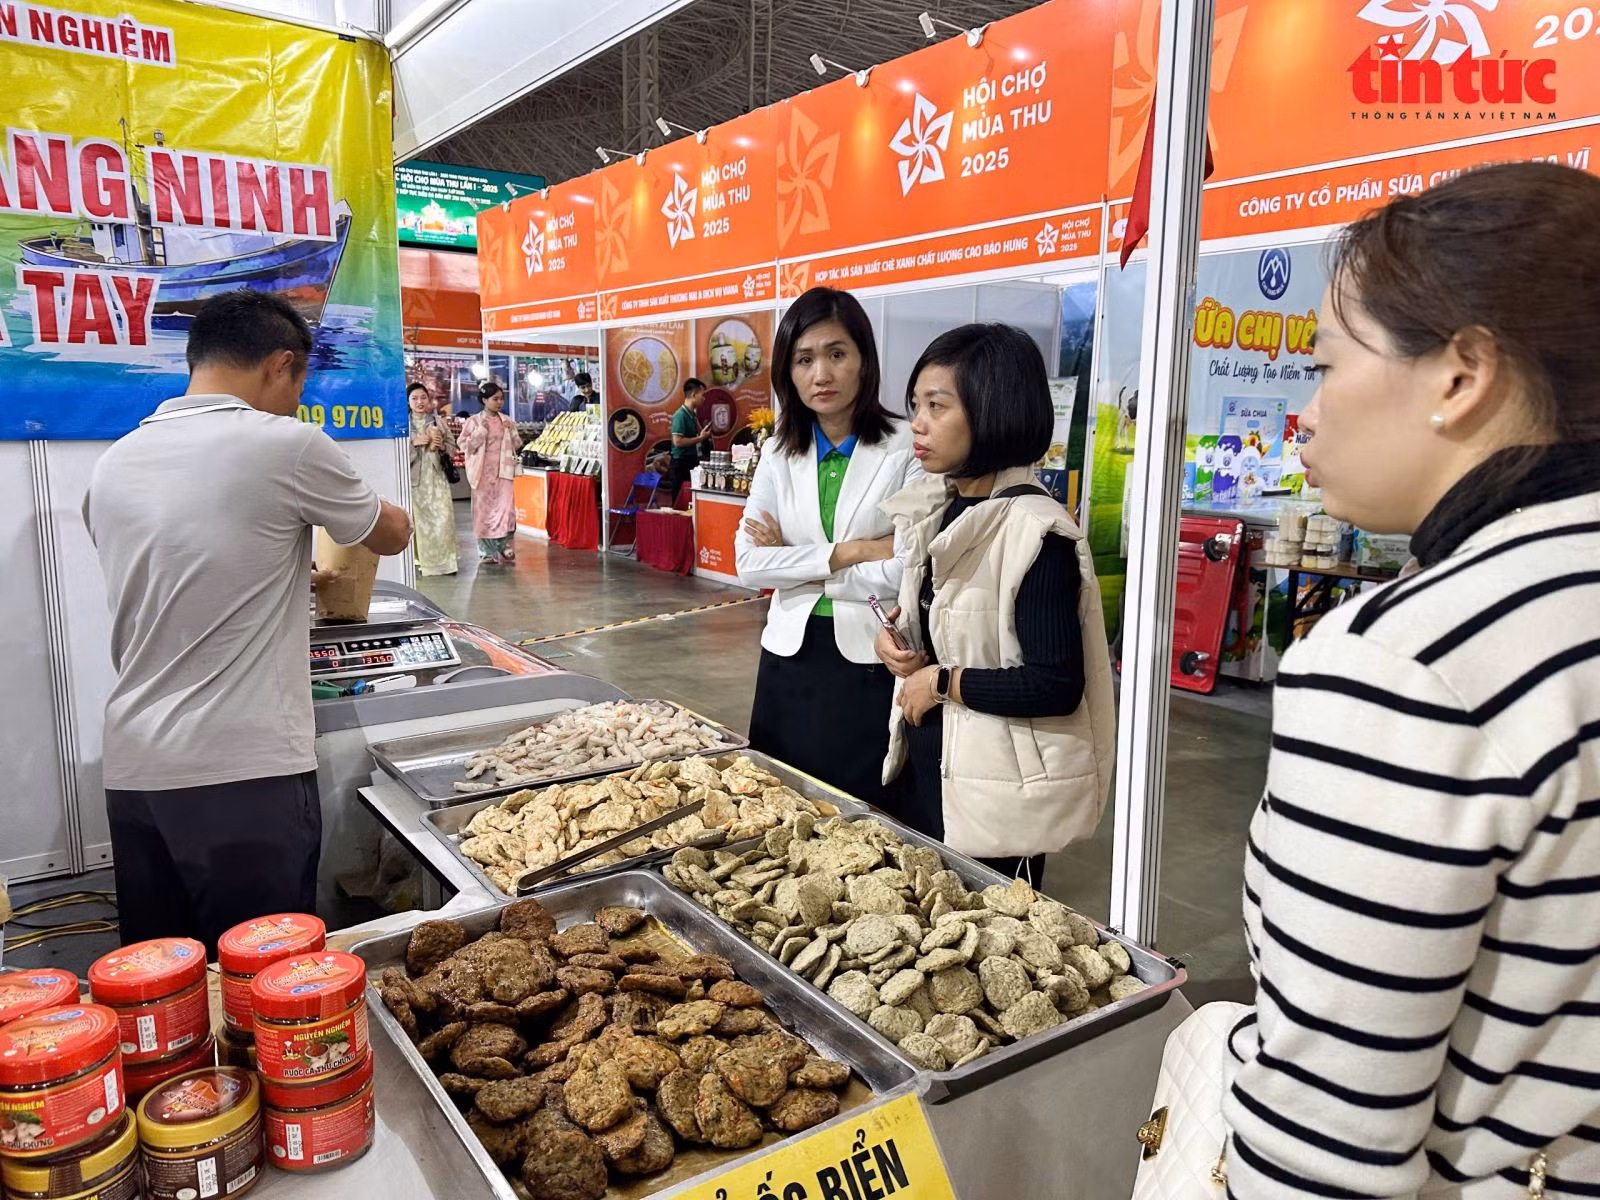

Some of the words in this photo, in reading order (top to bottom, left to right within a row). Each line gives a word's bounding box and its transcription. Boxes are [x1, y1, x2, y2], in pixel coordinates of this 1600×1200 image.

[28, 9, 171, 63] NGHIÊM
[1532, 6, 1600, 49] 20
[963, 76, 996, 110] HỘI
[1001, 60, 1047, 94] CHỢ
[962, 111, 1004, 144] MÙA
[1010, 100, 1052, 130] THU
[701, 164, 720, 189] HỘI
[722, 155, 747, 180] CHỢ
[961, 146, 1009, 177] 2025
[0, 134, 129, 219] NG
[150, 151, 332, 237] NINH
[702, 189, 726, 213] MÙA
[728, 184, 751, 206] THU
[1239, 196, 1281, 217] CÔNG
[1284, 192, 1305, 211] TY
[1307, 182, 1331, 207] CỔ
[1335, 176, 1383, 203] PHẦN
[1387, 173, 1424, 197] SỮA
[559, 209, 575, 230] CHỢ
[703, 217, 730, 238] 2025
[1077, 229, 1092, 240] THU
[563, 232, 578, 249] THU
[895, 256, 916, 270] XANH
[917, 249, 936, 267] CHẤT
[936, 246, 963, 264] LƯỢNG
[965, 244, 982, 259] CAO
[1003, 237, 1029, 253] HƯNG
[1060, 243, 1078, 253] 2025
[548, 256, 566, 272] 2025
[22, 269, 155, 346] TAY
[1194, 298, 1235, 348] ỮA
[1237, 310, 1283, 361] CHỊ
[1286, 309, 1318, 354] VÀ
[1209, 356, 1230, 377] Chất
[1233, 361, 1258, 384] Lượng
[1263, 363, 1277, 384] Tạo
[1280, 362, 1301, 381] Niềm
[332, 405, 384, 428] 9709
[293, 1029, 324, 1042] NGUYÊN
[325, 1018, 351, 1036] NGHIÊM
[815, 1128, 910, 1200] BIỂN
